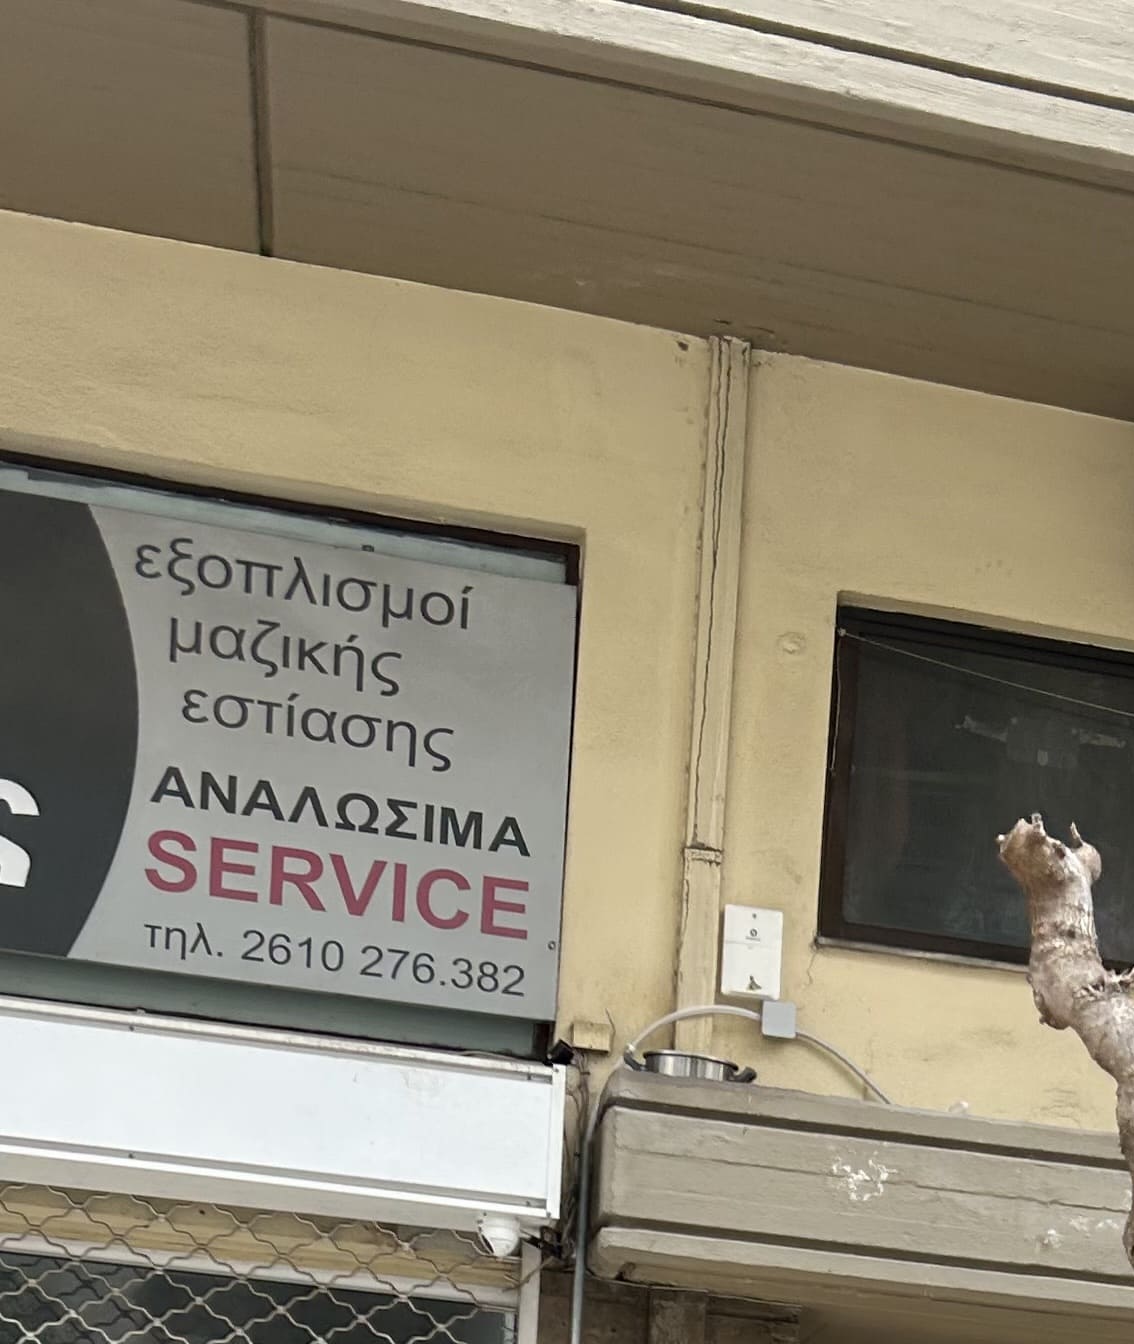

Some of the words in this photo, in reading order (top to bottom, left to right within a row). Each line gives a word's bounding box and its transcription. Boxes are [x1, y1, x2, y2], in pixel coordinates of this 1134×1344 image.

[134, 537, 475, 630] εξοπλισμοί
[168, 616, 403, 697] μαζικής
[181, 688, 455, 773] εστίασης
[149, 765, 532, 858] ΑΝΑΛΩΣΙΜΑ
[143, 829, 531, 940] SERVICE
[143, 921, 224, 961] τηλ.
[240, 929, 345, 973] 2610
[359, 945, 526, 998] 276.382
